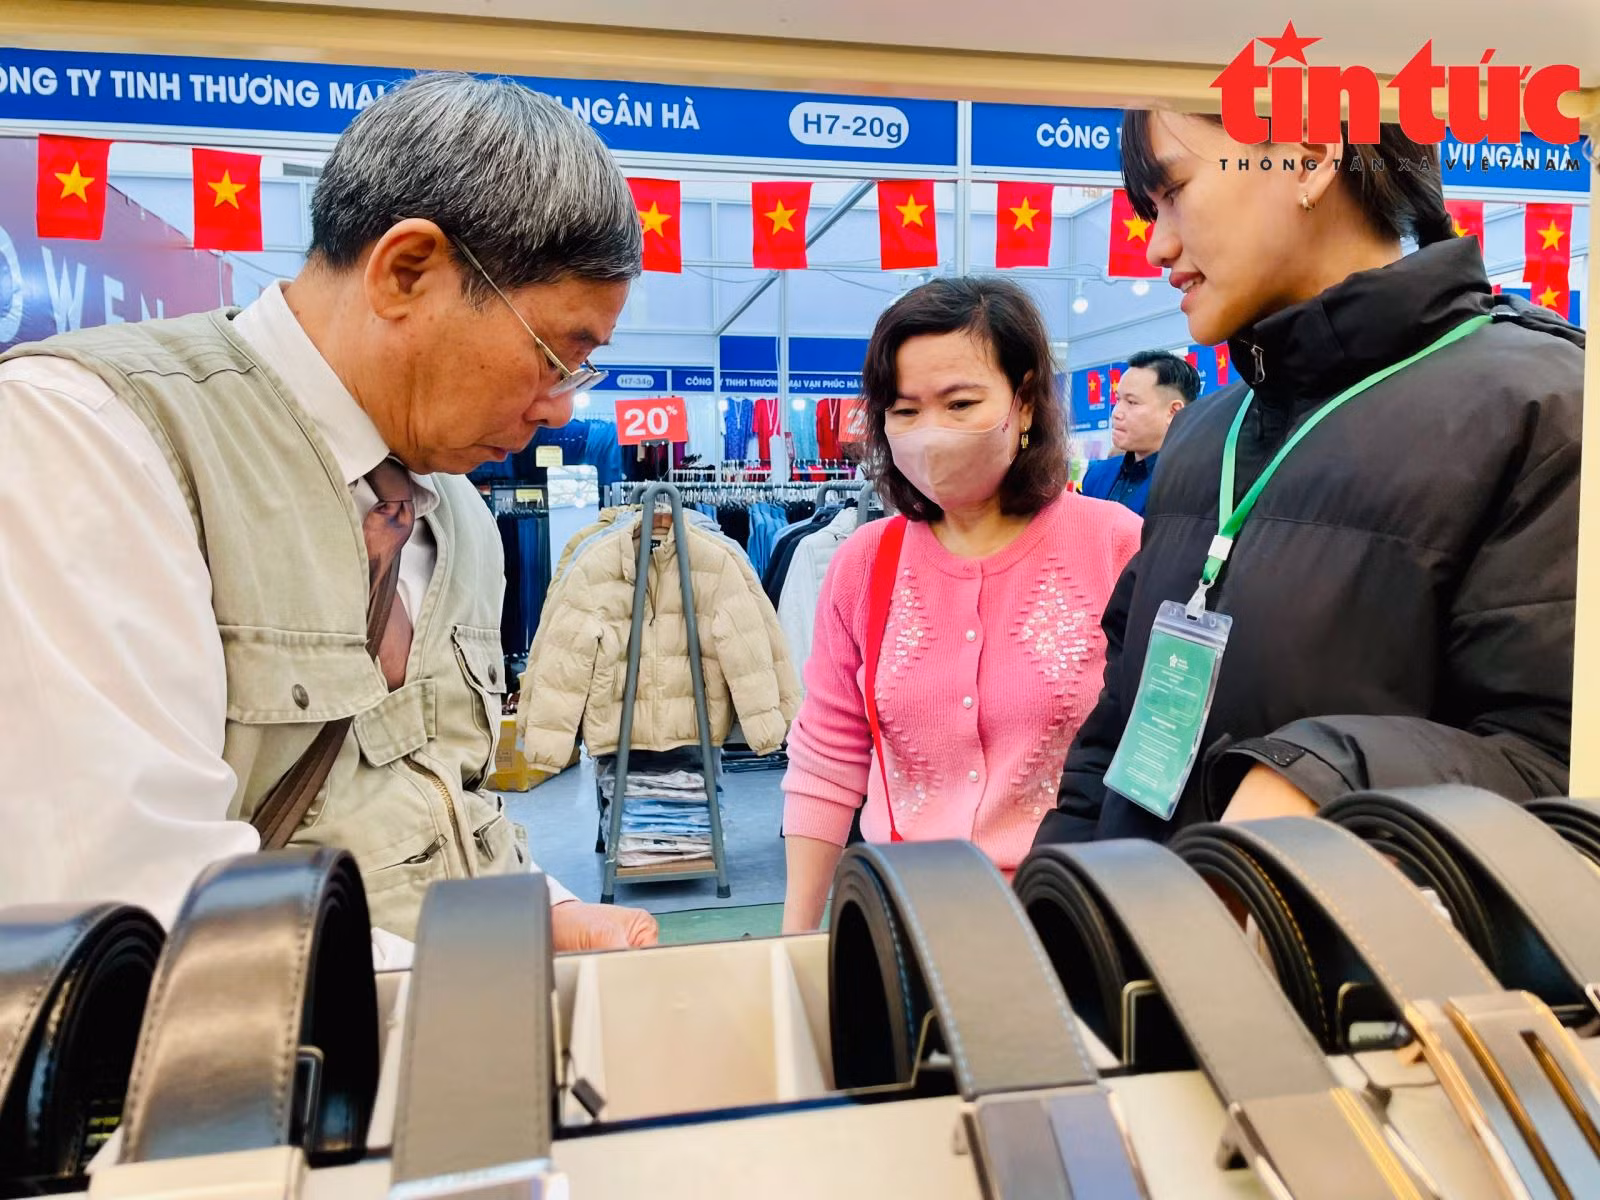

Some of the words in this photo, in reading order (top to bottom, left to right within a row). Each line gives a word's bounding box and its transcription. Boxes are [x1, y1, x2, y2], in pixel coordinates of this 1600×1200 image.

[66, 68, 101, 97] TY
[110, 70, 180, 101] TINH
[189, 72, 320, 108] THƯƠNG
[572, 93, 653, 128] NGÂN
[661, 96, 700, 130] HÀ
[803, 112, 902, 144] H7-20g
[1036, 117, 1111, 150] CÔNG
[685, 375, 712, 386] CÔNG
[749, 378, 778, 388] THƯƠN
[803, 380, 820, 390] VẠN
[822, 378, 845, 389] PHÚC
[847, 378, 859, 389] HÀ
